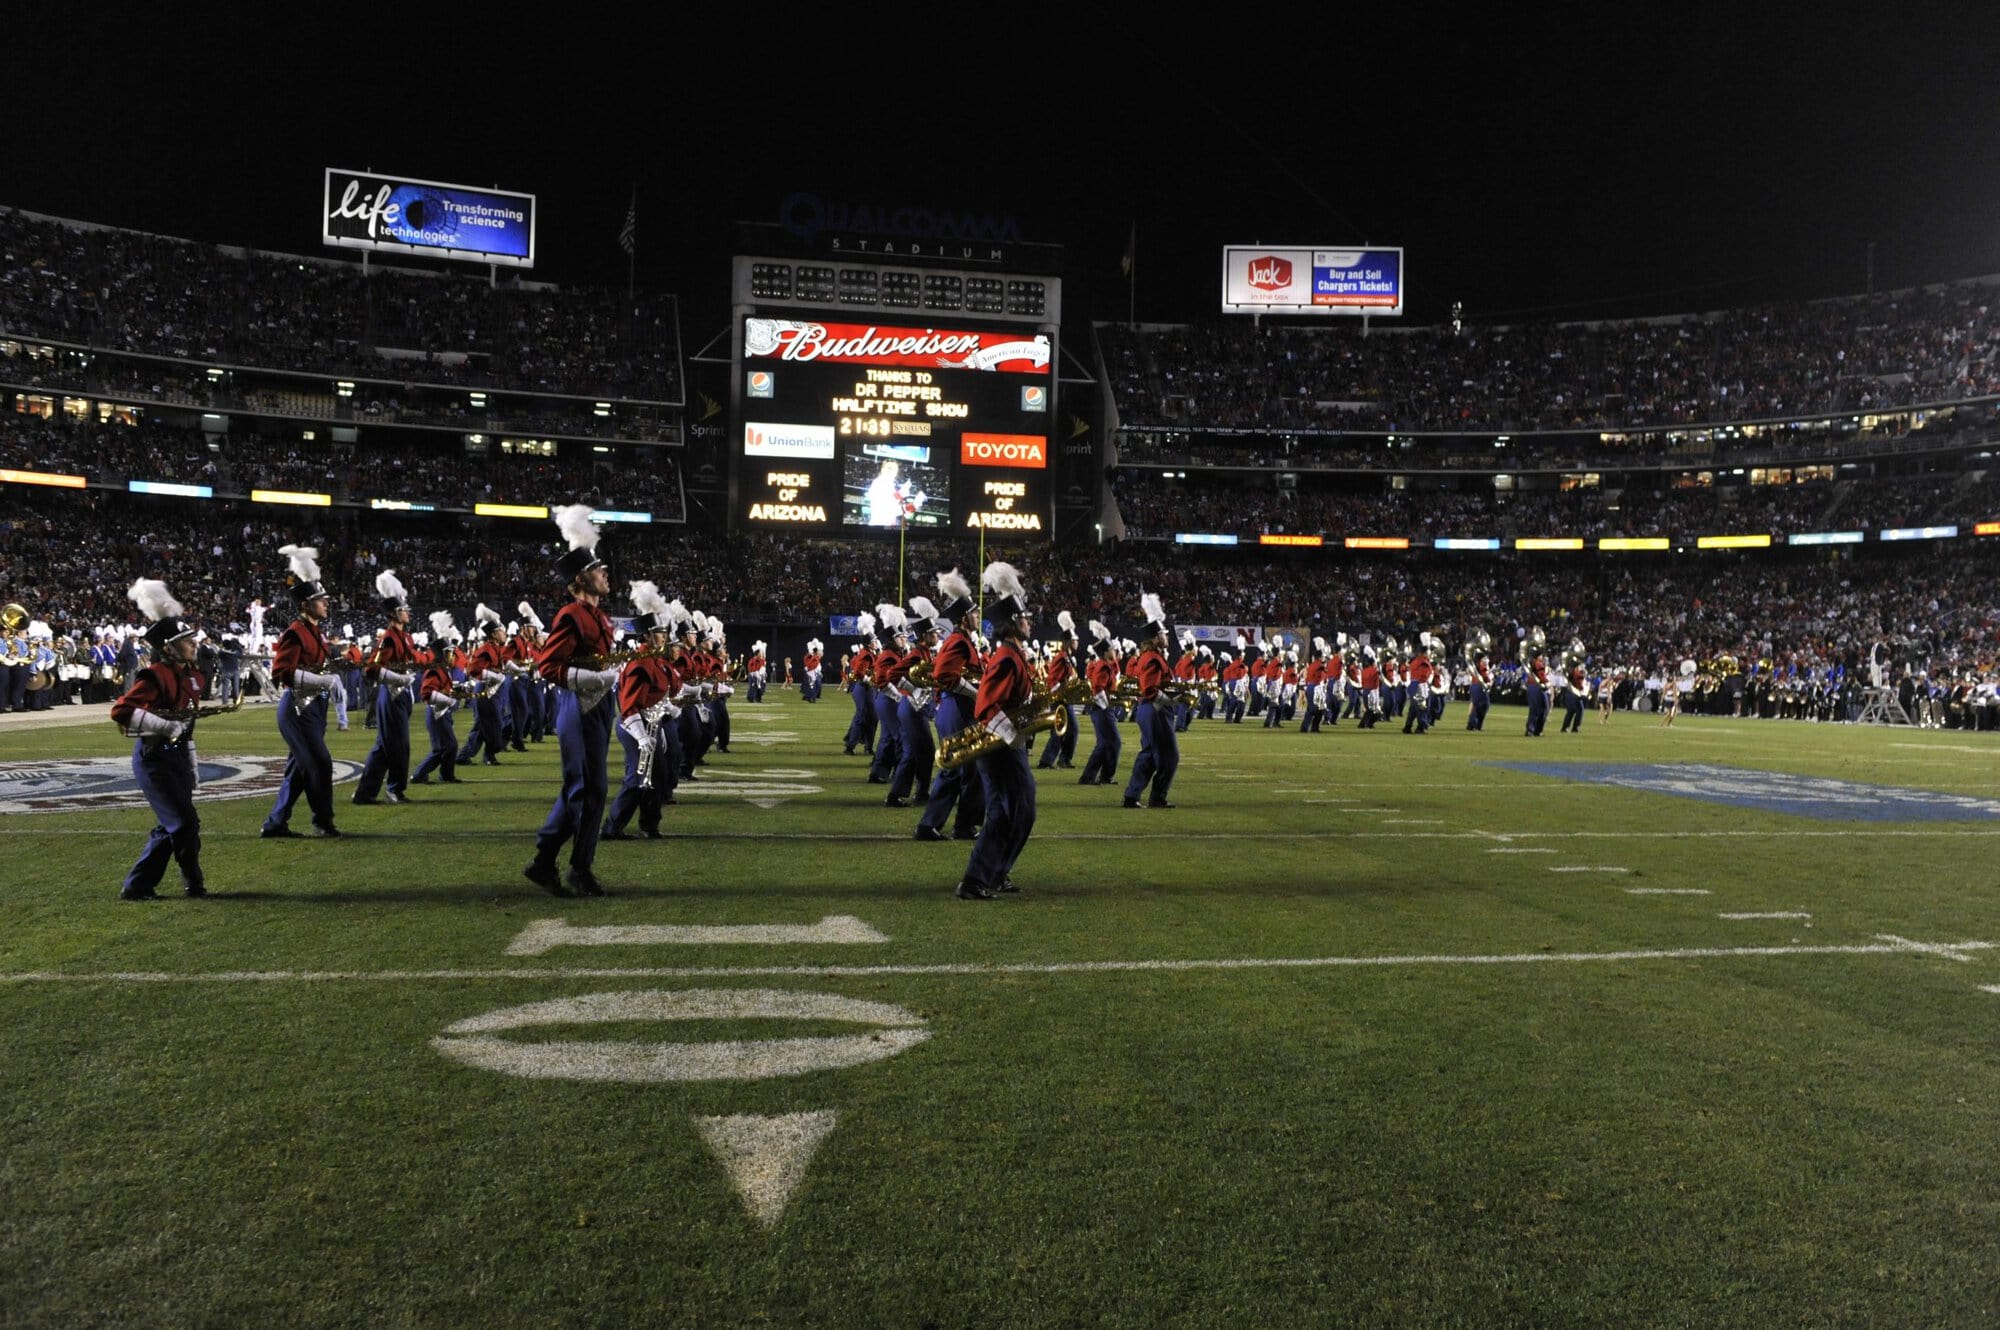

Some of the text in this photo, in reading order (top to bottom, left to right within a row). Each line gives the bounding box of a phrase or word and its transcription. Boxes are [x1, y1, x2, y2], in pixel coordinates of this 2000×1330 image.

[330, 180, 400, 237] life
[442, 201, 524, 222] Transforming
[460, 215, 505, 228] science
[380, 225, 456, 242] technologies
[1250, 259, 1291, 286] Jack
[1329, 268, 1382, 281] Buy and Sell
[1318, 280, 1393, 293] Chargers Tickets!
[774, 326, 981, 361] Budweiser
[866, 369, 932, 384] THANKS TO
[855, 383, 941, 400] DR PEPPER
[832, 398, 968, 418] HALFTIME SHOW
[966, 442, 1042, 460] TOYOTA
[767, 472, 810, 487] PRIDE
[778, 488, 798, 502] OF
[984, 482, 1025, 497] PRIDE
[749, 504, 827, 522] ARIZONA
[995, 498, 1014, 511] OF
[967, 512, 1041, 530] ARIZONA
